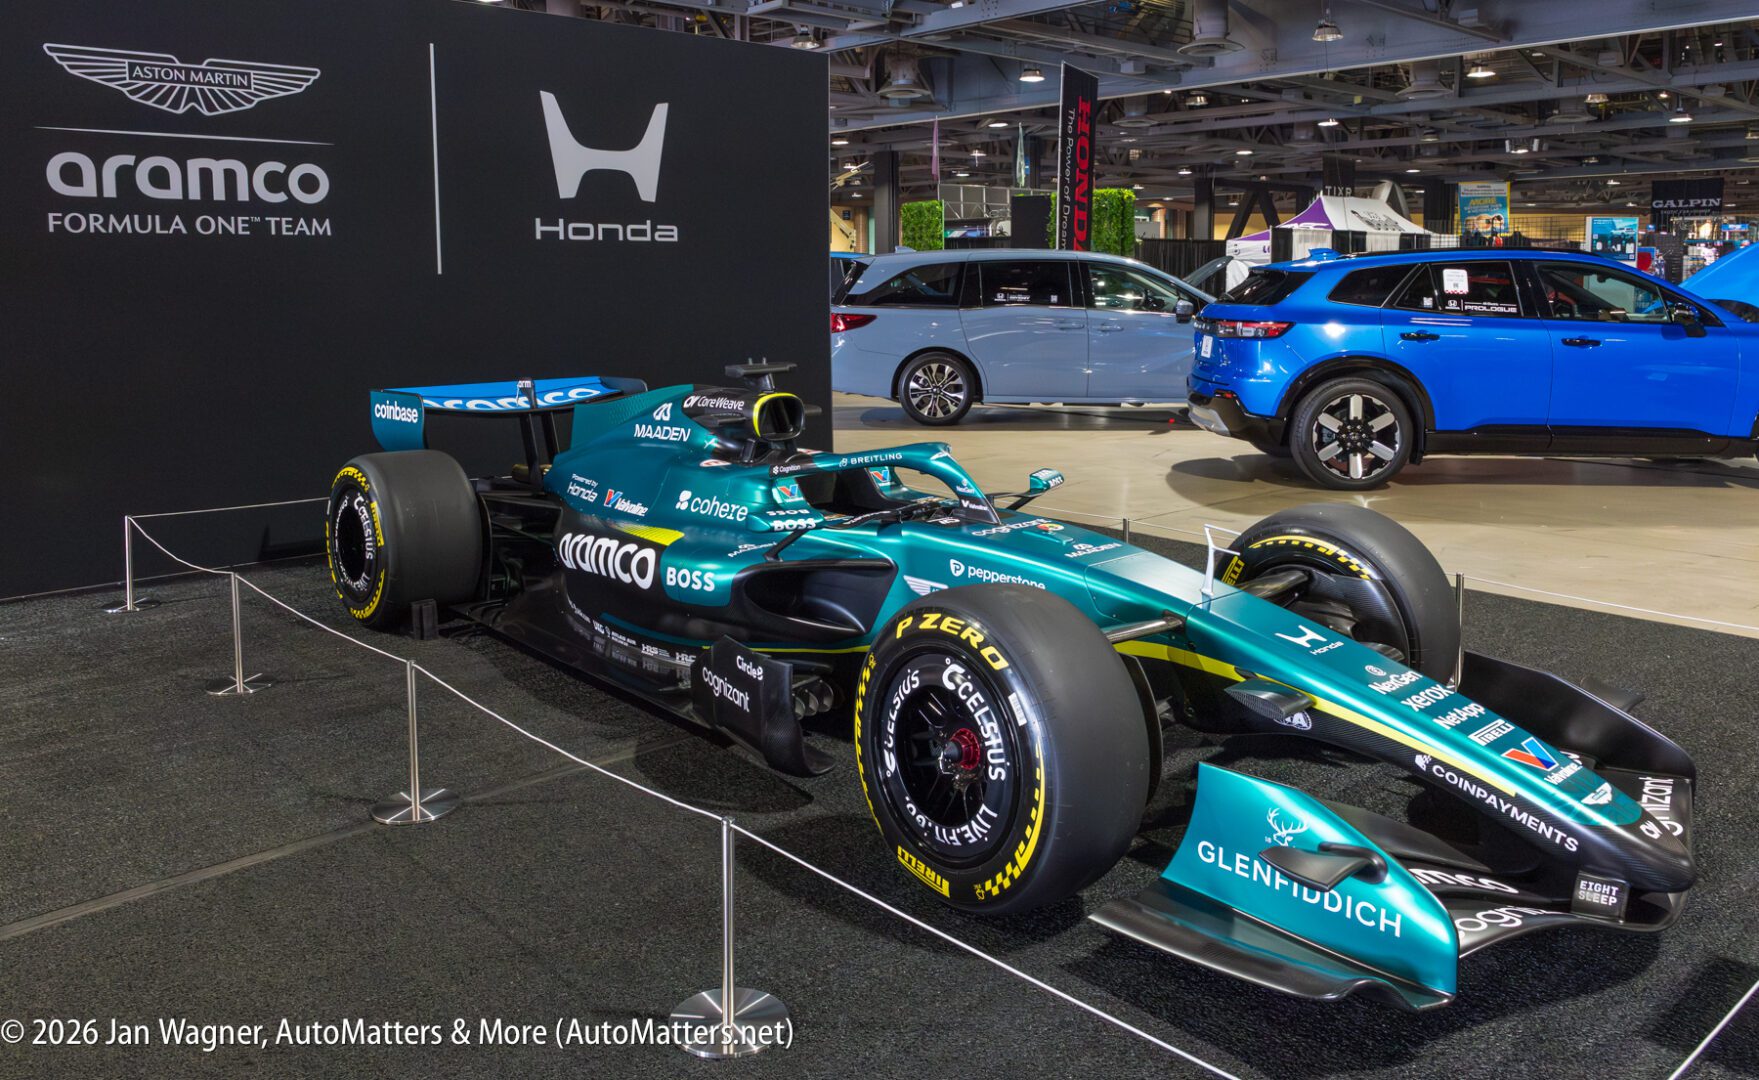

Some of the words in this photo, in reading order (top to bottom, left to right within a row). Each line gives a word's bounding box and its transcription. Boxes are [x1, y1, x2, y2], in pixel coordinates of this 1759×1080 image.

[132, 65, 186, 82] ASTON
[190, 71, 248, 87] MARTIN
[1066, 108, 1076, 134] The
[1064, 138, 1074, 184] Power
[46, 151, 330, 204] aramco
[1062, 186, 1071, 202] of
[1652, 198, 1721, 208] GALPIN
[48, 212, 188, 235] FORMULA
[265, 216, 332, 236] TEAM
[535, 217, 678, 242] Honda
[1464, 305, 1517, 313] PROLOGUE
[374, 400, 418, 424] coinbase
[697, 396, 745, 410] CoreWeave
[633, 424, 691, 442] MAADEN
[851, 452, 902, 465] BREITLING
[567, 482, 598, 503] Honda
[690, 496, 748, 522] cohere
[773, 518, 816, 531] BOSS
[559, 532, 656, 590] aramco
[666, 566, 715, 592] BOSS
[896, 616, 913, 639] P
[919, 613, 1009, 670] ZERO
[1310, 641, 1344, 656] Honda
[737, 655, 757, 679] Circle
[702, 667, 750, 712] cognizant
[1368, 670, 1423, 695] NexGen
[1401, 684, 1455, 712] xerox
[1433, 702, 1486, 730] NetApp
[958, 680, 1008, 781] CELSIUS
[1467, 718, 1516, 746] PIRELLI
[1432, 764, 1579, 852] COINPAYMENTS
[898, 846, 950, 898] PIRELLI
[1197, 840, 1402, 938] GLENFIDDICH
[1578, 890, 1617, 906] SLEEP
[1580, 880, 1619, 896] EIGHT
